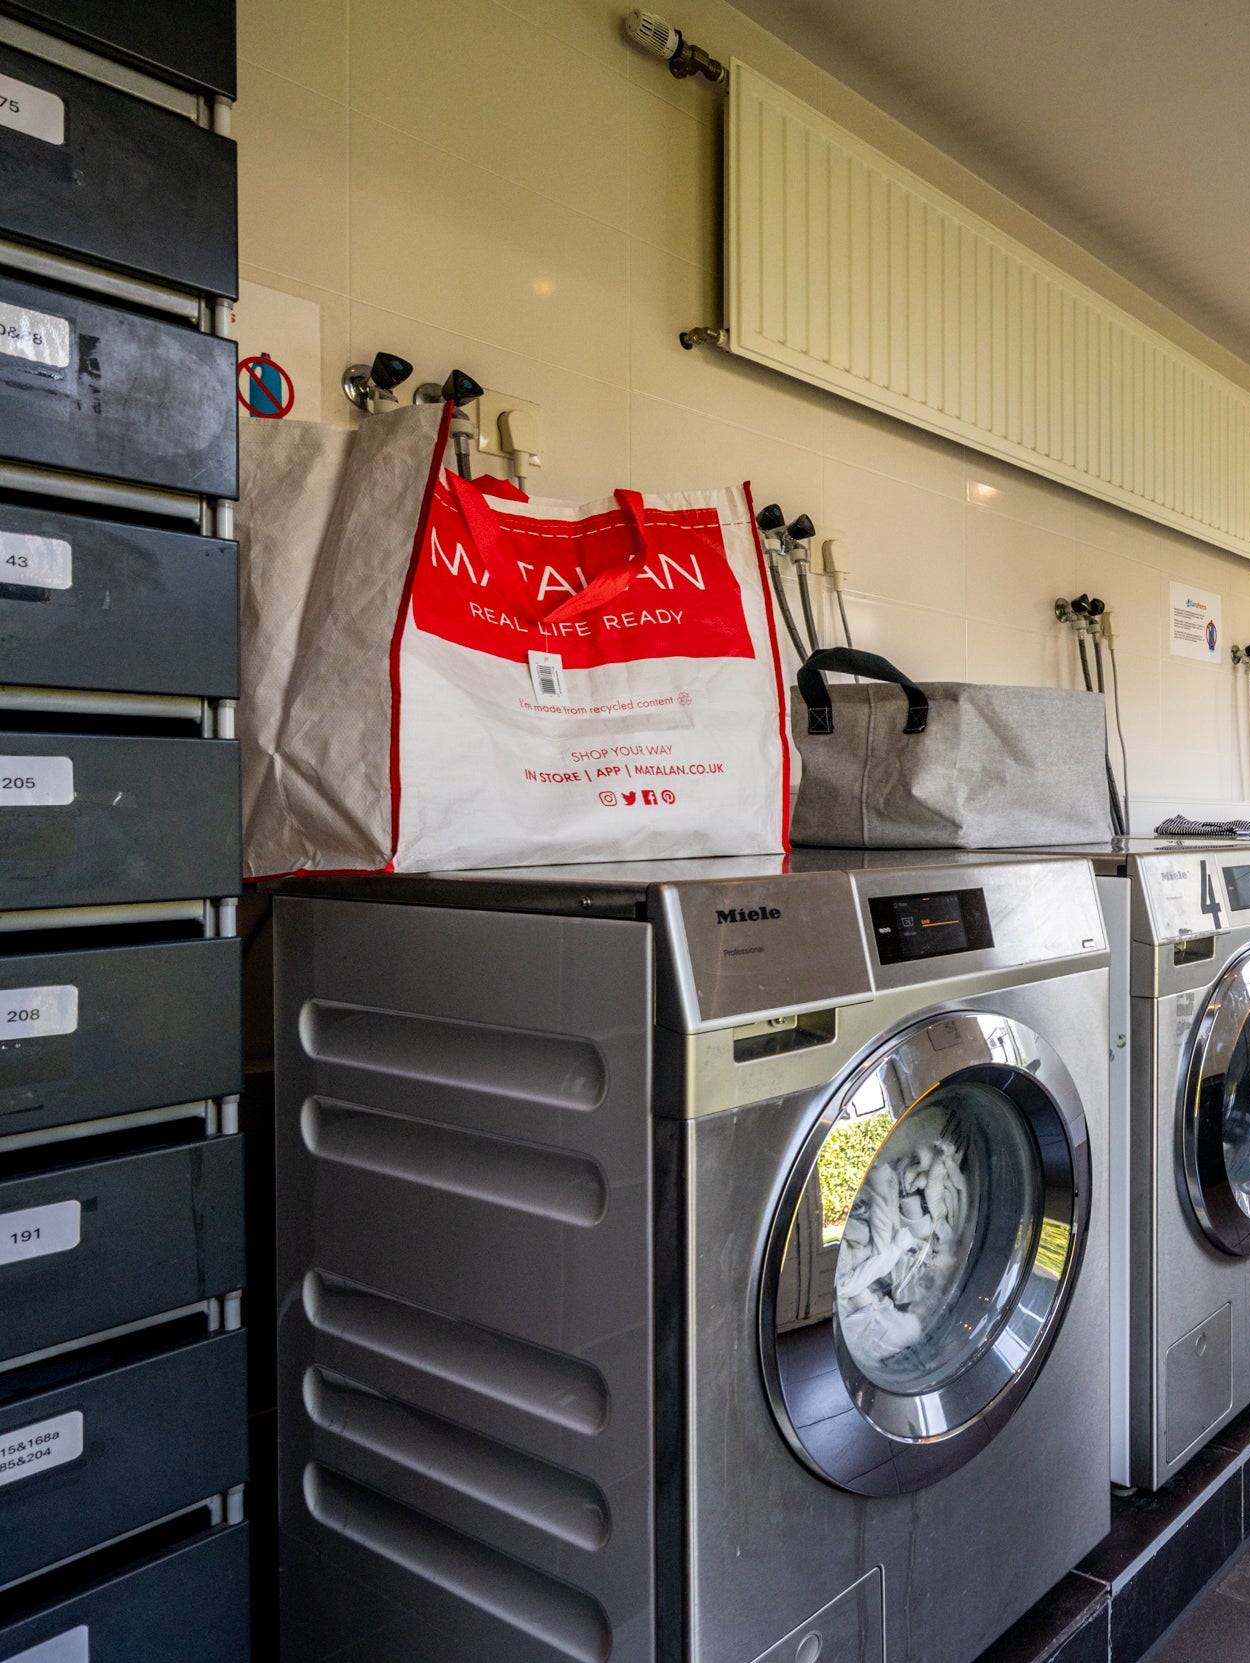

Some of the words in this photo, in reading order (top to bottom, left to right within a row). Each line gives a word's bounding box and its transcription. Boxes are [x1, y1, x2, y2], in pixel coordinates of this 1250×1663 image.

[6, 555, 28, 568] 43
[469, 602, 528, 632] REAL
[538, 621, 591, 637] LIFE
[603, 609, 684, 631] READY
[534, 704, 562, 714] made
[590, 701, 635, 716] recycled
[637, 696, 674, 709] content
[571, 749, 608, 763] SHOP
[610, 745, 645, 756] YOUR
[646, 744, 673, 755] WAY
[525, 768, 537, 781] IN
[540, 772, 581, 783] STORE
[597, 766, 621, 778] APP
[634, 763, 724, 776] MATALAN.CO.UK
[2, 777, 36, 789] 205
[1160, 870, 1189, 882] Miele
[1200, 860, 1222, 930] 4
[716, 906, 781, 925] Miele
[723, 946, 765, 957] Professional
[7, 1008, 40, 1023] 208
[10, 1228, 40, 1244] 191
[0, 1431, 60, 1457] 15&168a
[0, 1447, 52, 1472] 85&204
